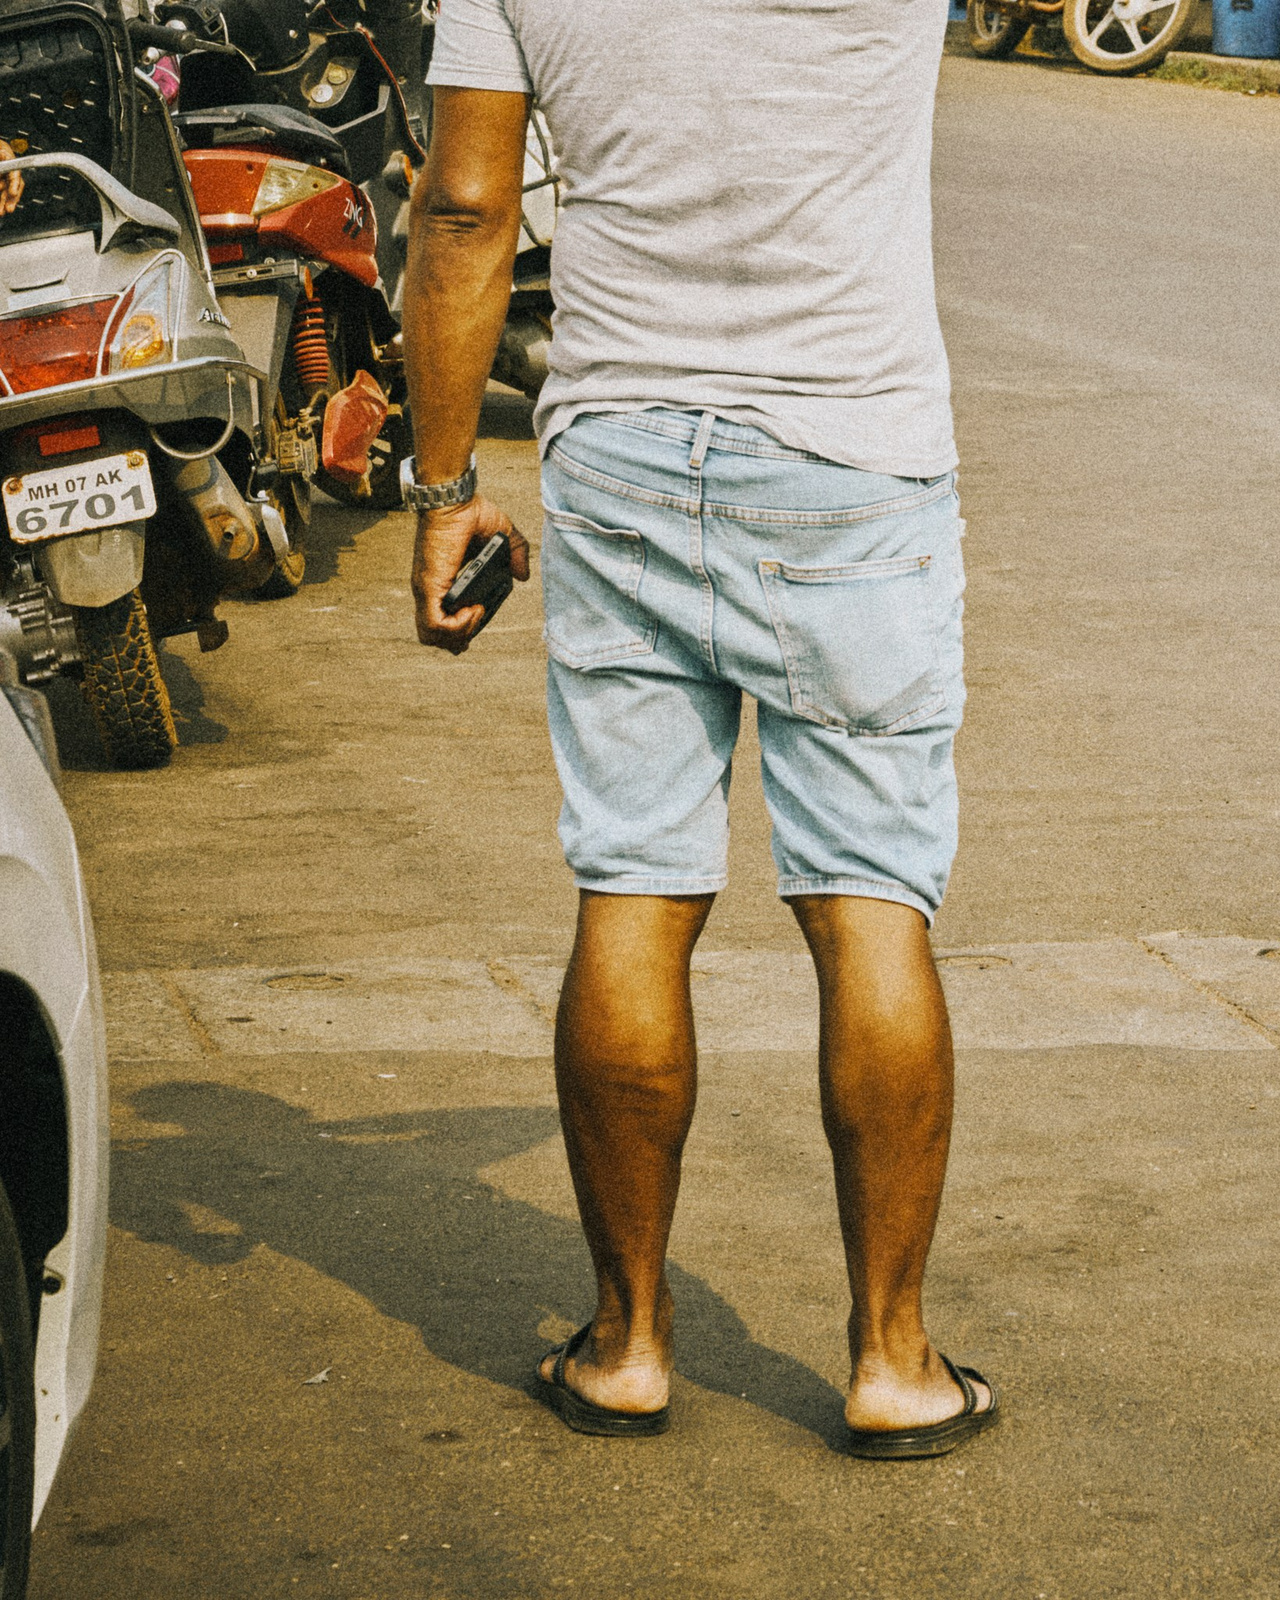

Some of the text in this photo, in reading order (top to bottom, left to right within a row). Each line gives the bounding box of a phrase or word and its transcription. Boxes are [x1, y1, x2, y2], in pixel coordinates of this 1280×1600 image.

[28, 469, 122, 501] MH 07 AK
[16, 485, 145, 534] 6701
